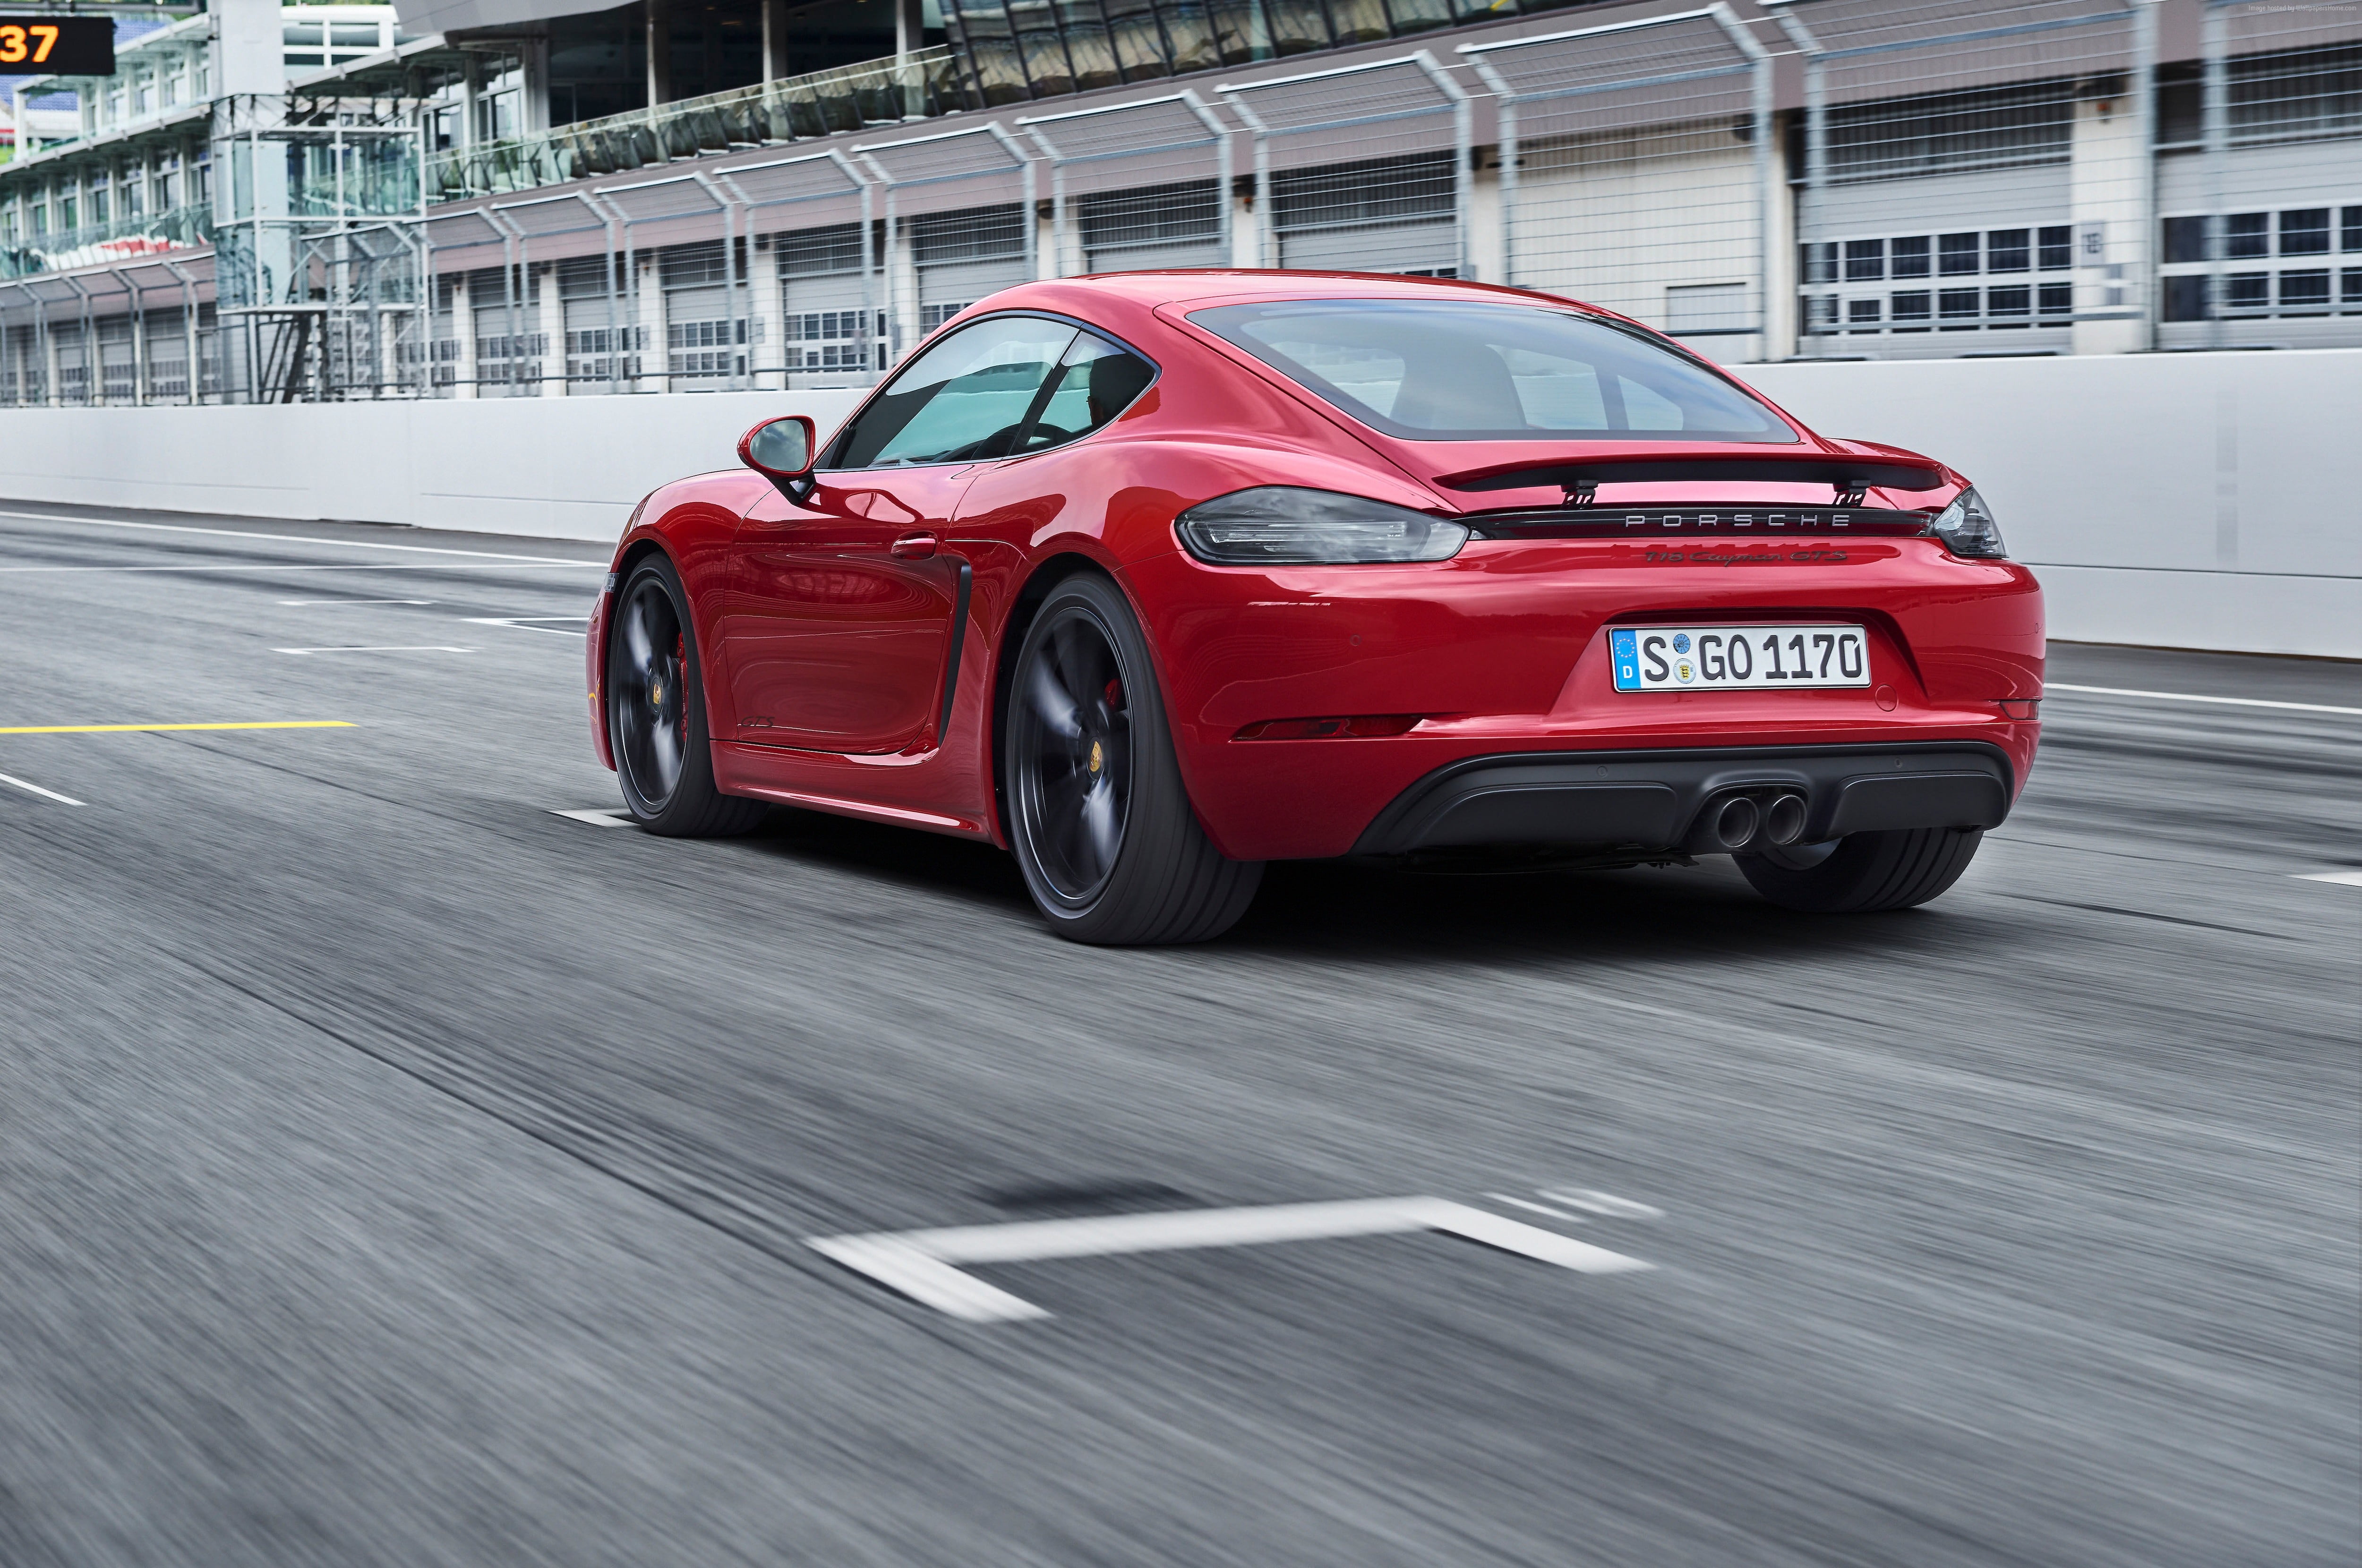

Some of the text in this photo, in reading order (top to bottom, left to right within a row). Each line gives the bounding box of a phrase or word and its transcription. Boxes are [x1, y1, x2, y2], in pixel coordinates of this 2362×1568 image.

[0, 25, 59, 62] 37
[1626, 514, 1849, 527] PORSCHE
[1646, 551, 1847, 567] 718 Cayman GTS
[1643, 636, 1669, 682] S
[1700, 634, 1752, 680] GO
[1763, 634, 1862, 679] 1170
[1623, 666, 1632, 678] D
[741, 716, 775, 727] GTS
